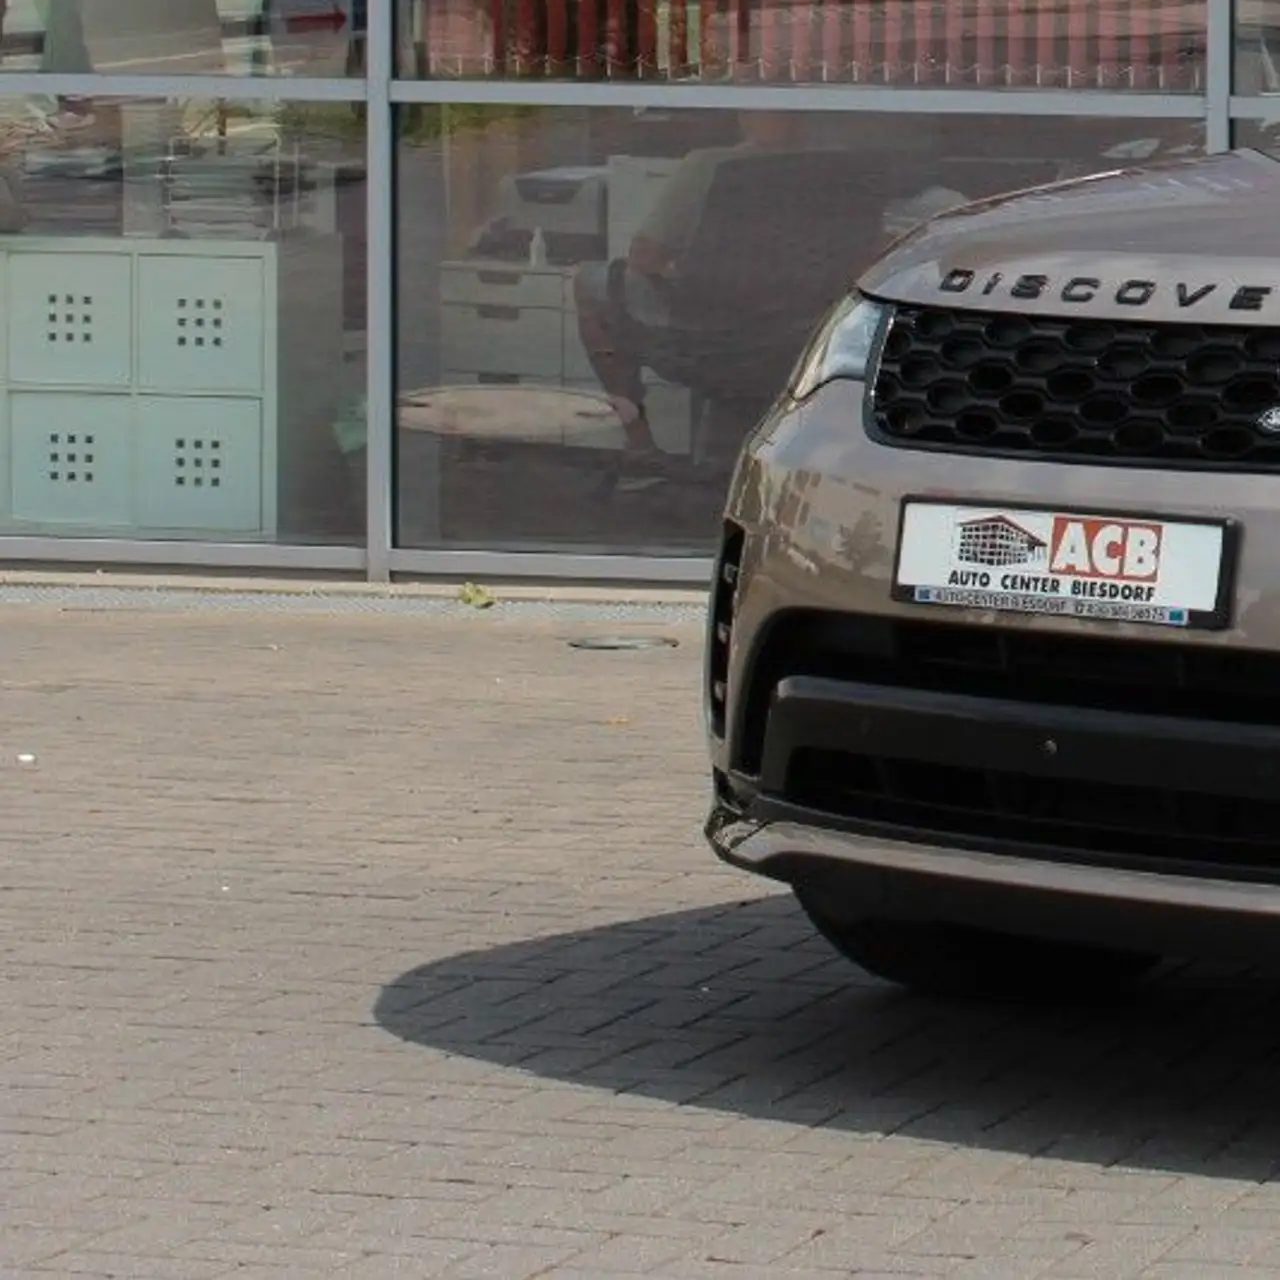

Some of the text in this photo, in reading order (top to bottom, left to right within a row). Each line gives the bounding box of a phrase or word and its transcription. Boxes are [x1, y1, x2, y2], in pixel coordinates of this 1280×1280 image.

[1050, 519, 1160, 578] ACB
[948, 570, 1156, 602] AUTO CENTER BIESDORF
